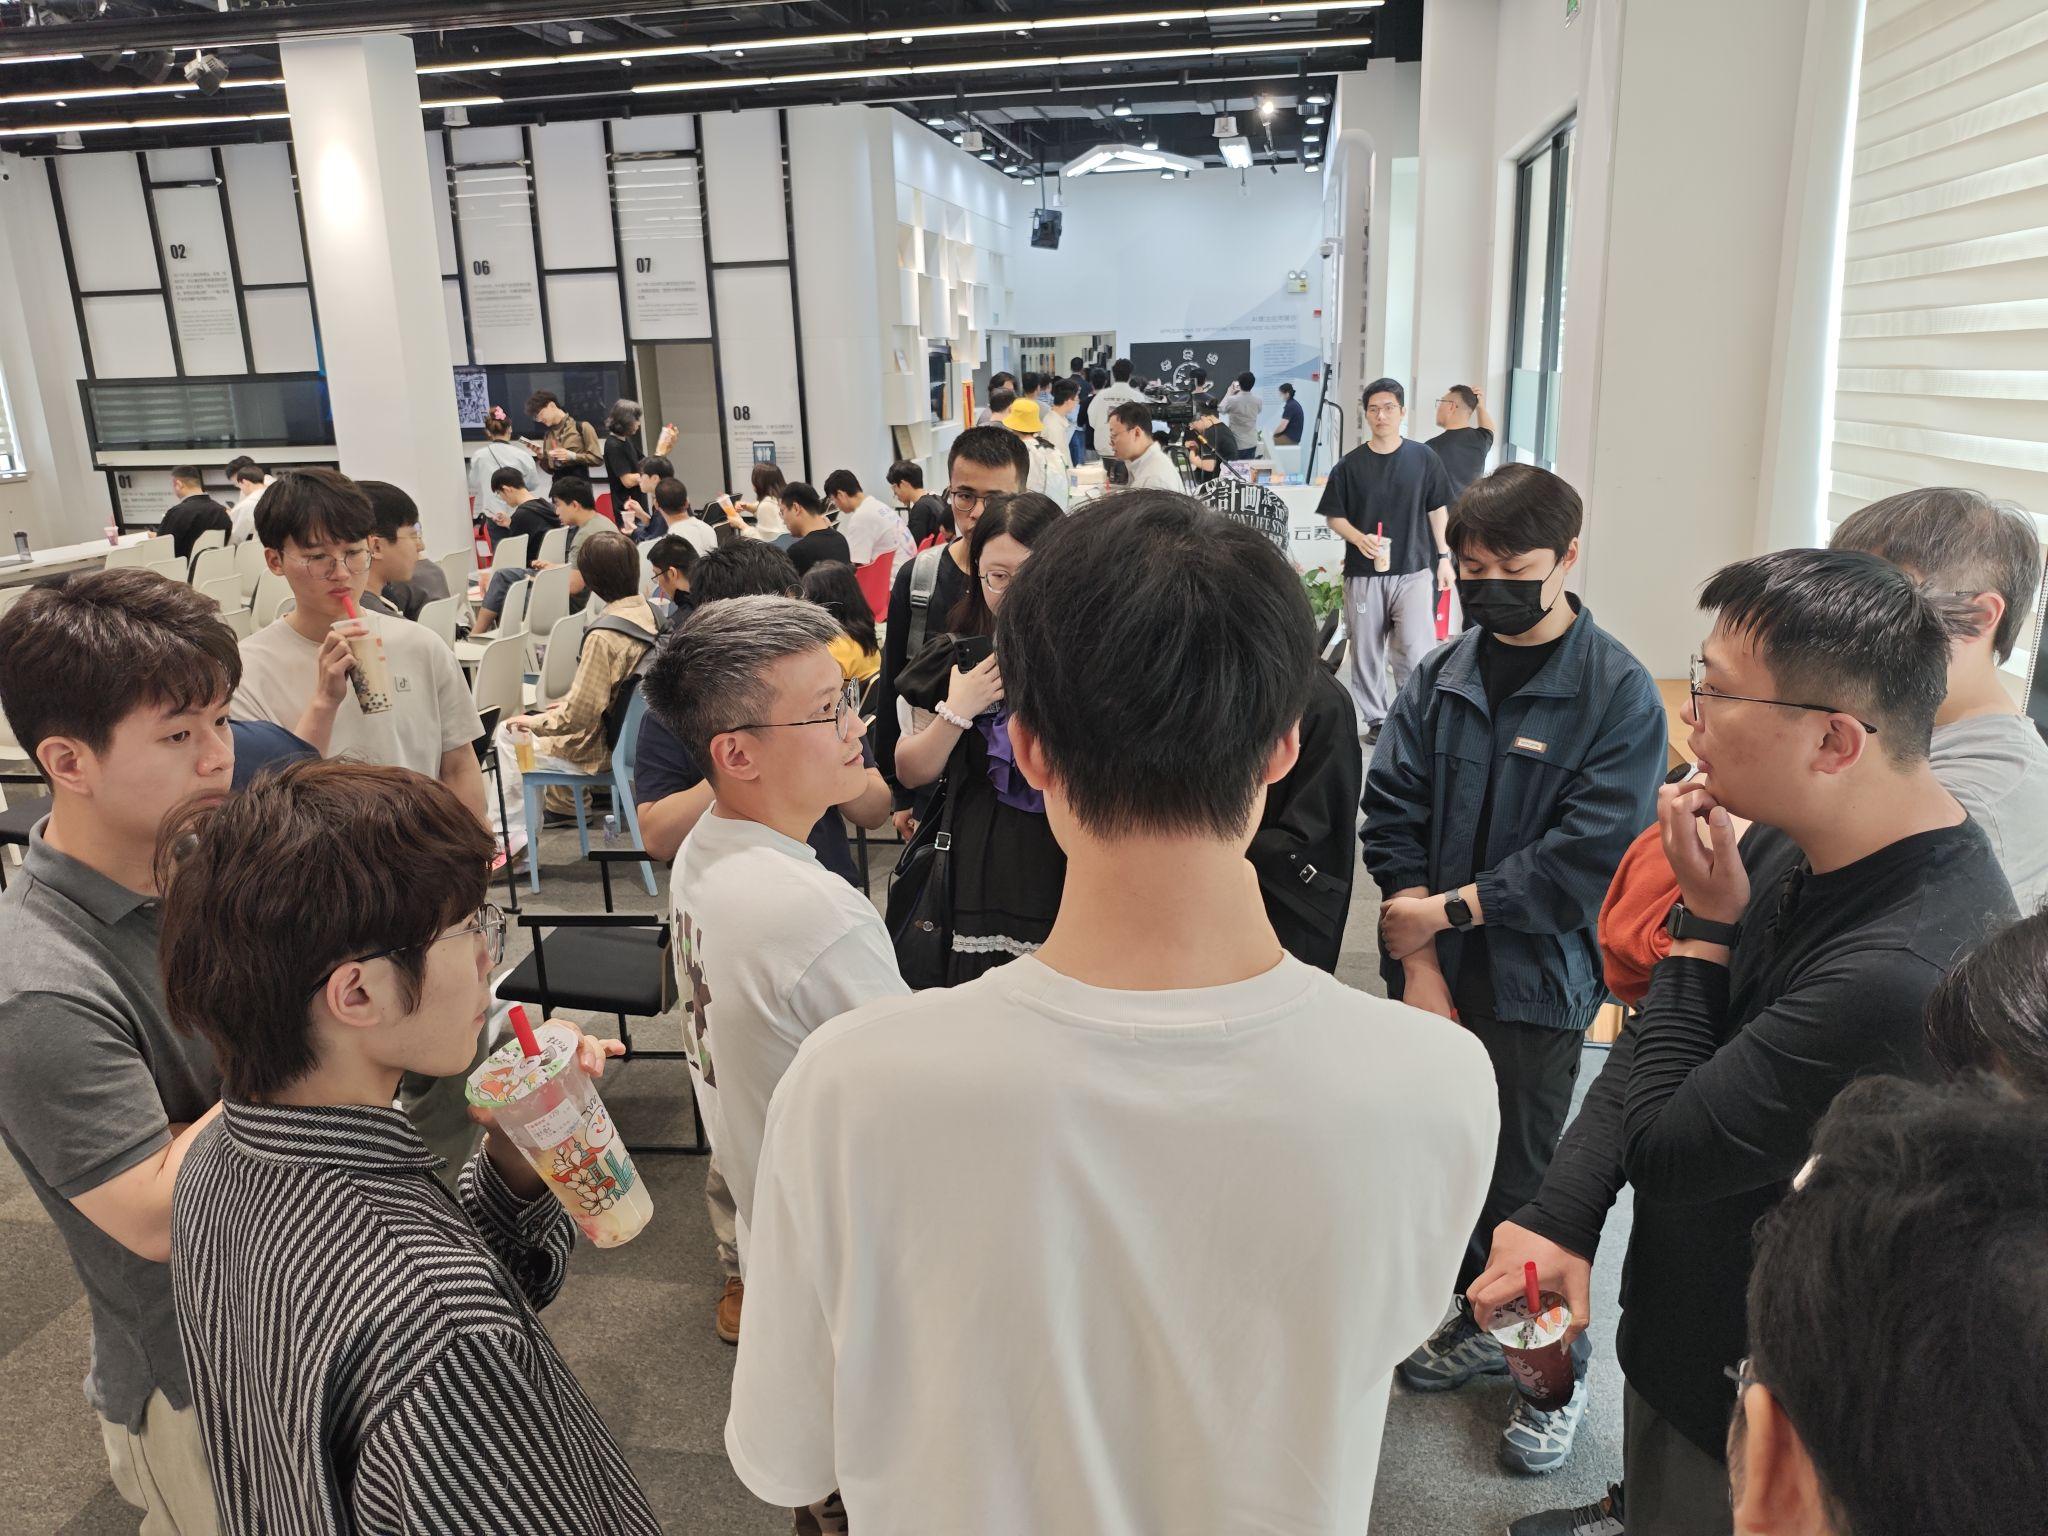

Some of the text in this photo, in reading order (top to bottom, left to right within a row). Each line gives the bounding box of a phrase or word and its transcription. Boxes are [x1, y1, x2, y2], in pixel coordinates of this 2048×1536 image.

[170, 244, 187, 259] 02
[473, 260, 490, 275] 06
[636, 257, 651, 273] 07
[733, 405, 751, 421] 08
[118, 474, 132, 489] 01
[1294, 525, 1343, 541] 云赛
